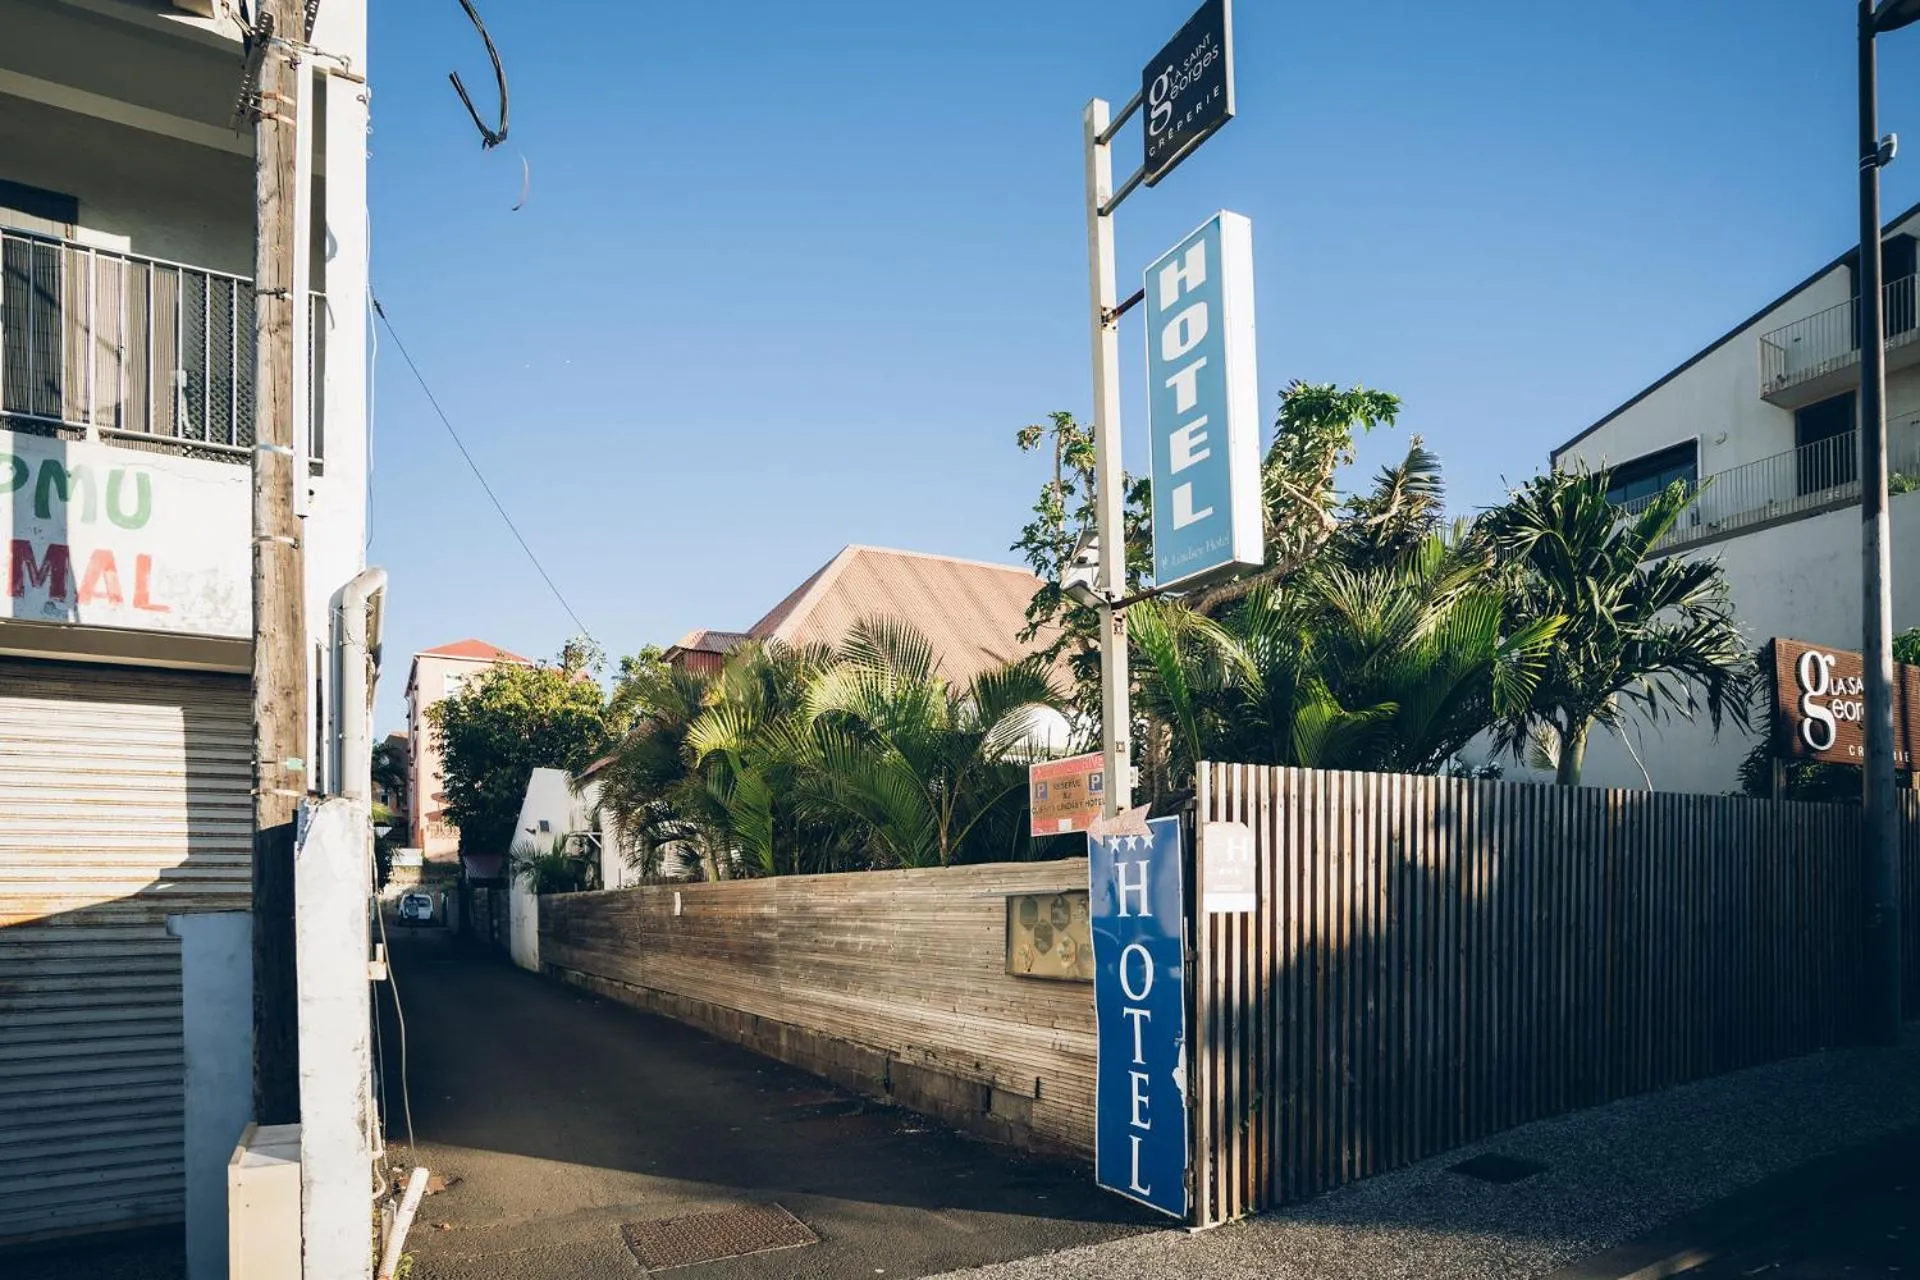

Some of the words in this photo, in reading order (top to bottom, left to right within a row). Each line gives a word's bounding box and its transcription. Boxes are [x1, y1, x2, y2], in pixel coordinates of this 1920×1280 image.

[1184, 32, 1210, 71] SAINT
[1159, 239, 1214, 531] HOTEL
[1116, 859, 1152, 1196] HOTEL
